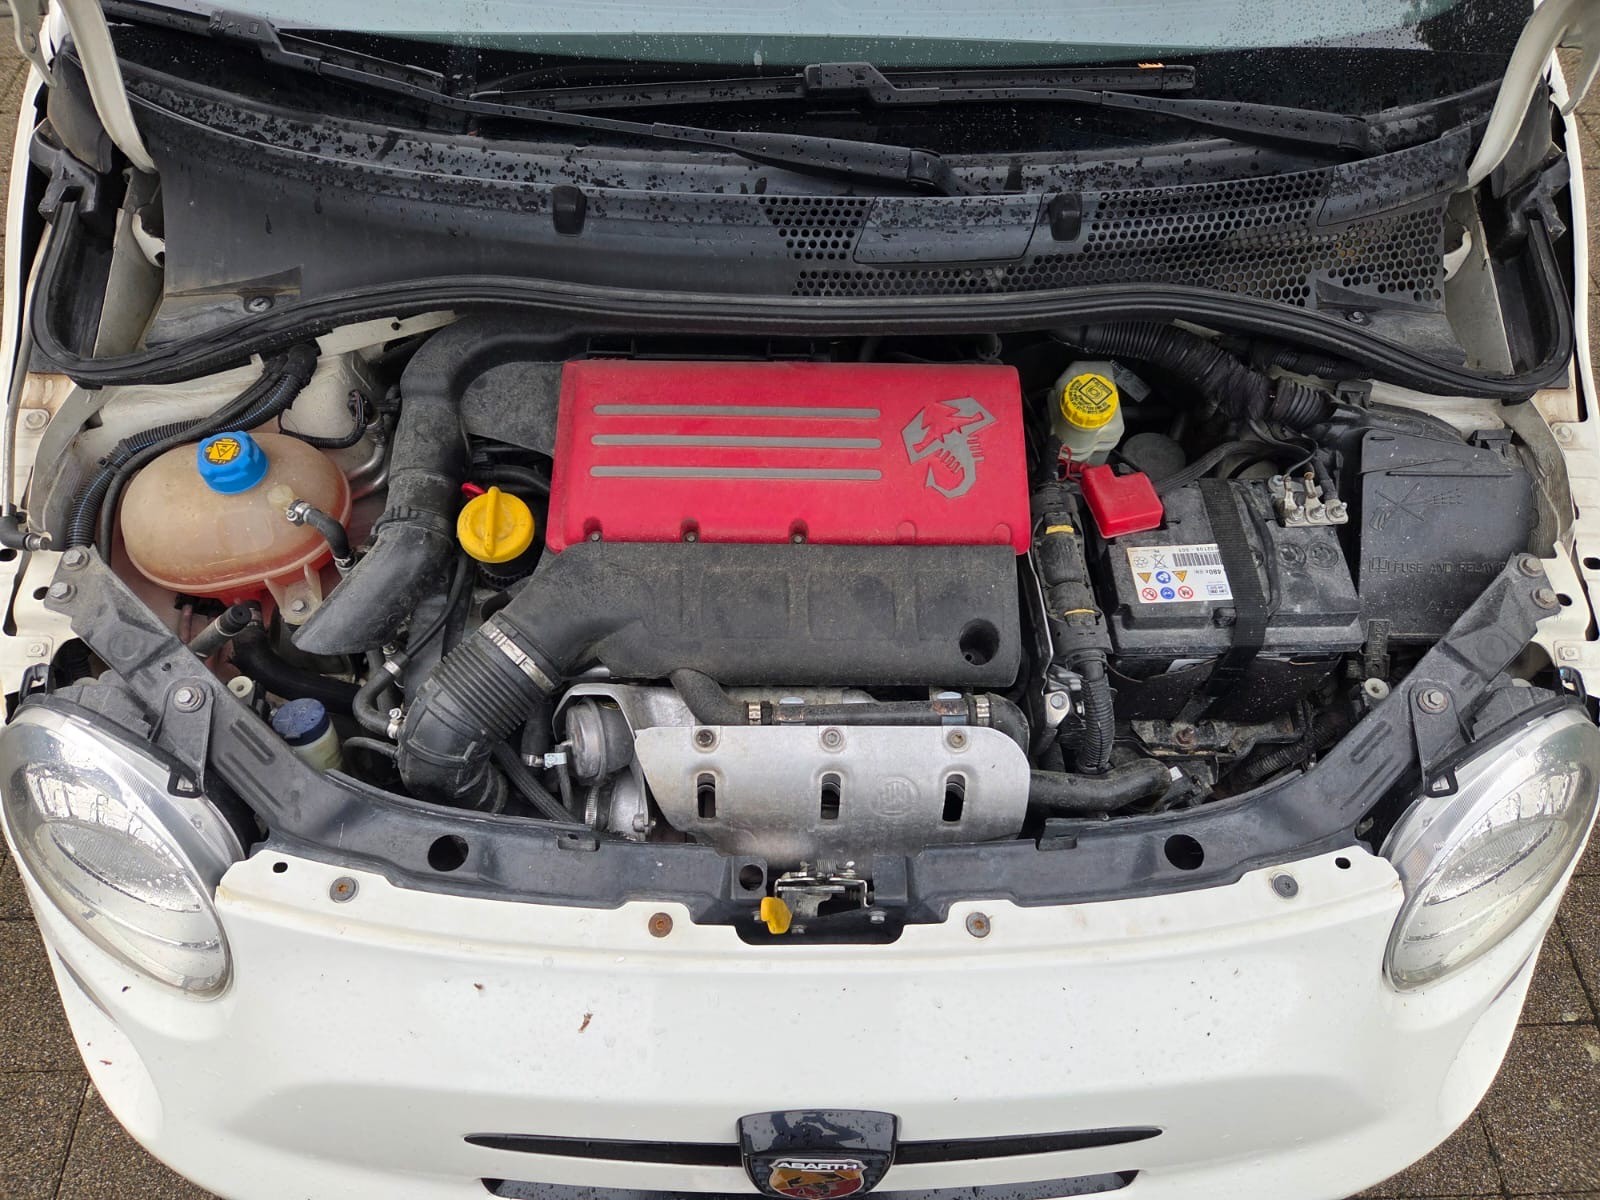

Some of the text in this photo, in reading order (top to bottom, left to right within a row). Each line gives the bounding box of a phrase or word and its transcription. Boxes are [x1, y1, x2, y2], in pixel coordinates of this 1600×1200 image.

[1394, 560, 1424, 573] FUSE
[1430, 560, 1454, 573] AND
[1458, 560, 1497, 573] RELAY
[777, 1162, 857, 1170] ABARTH
